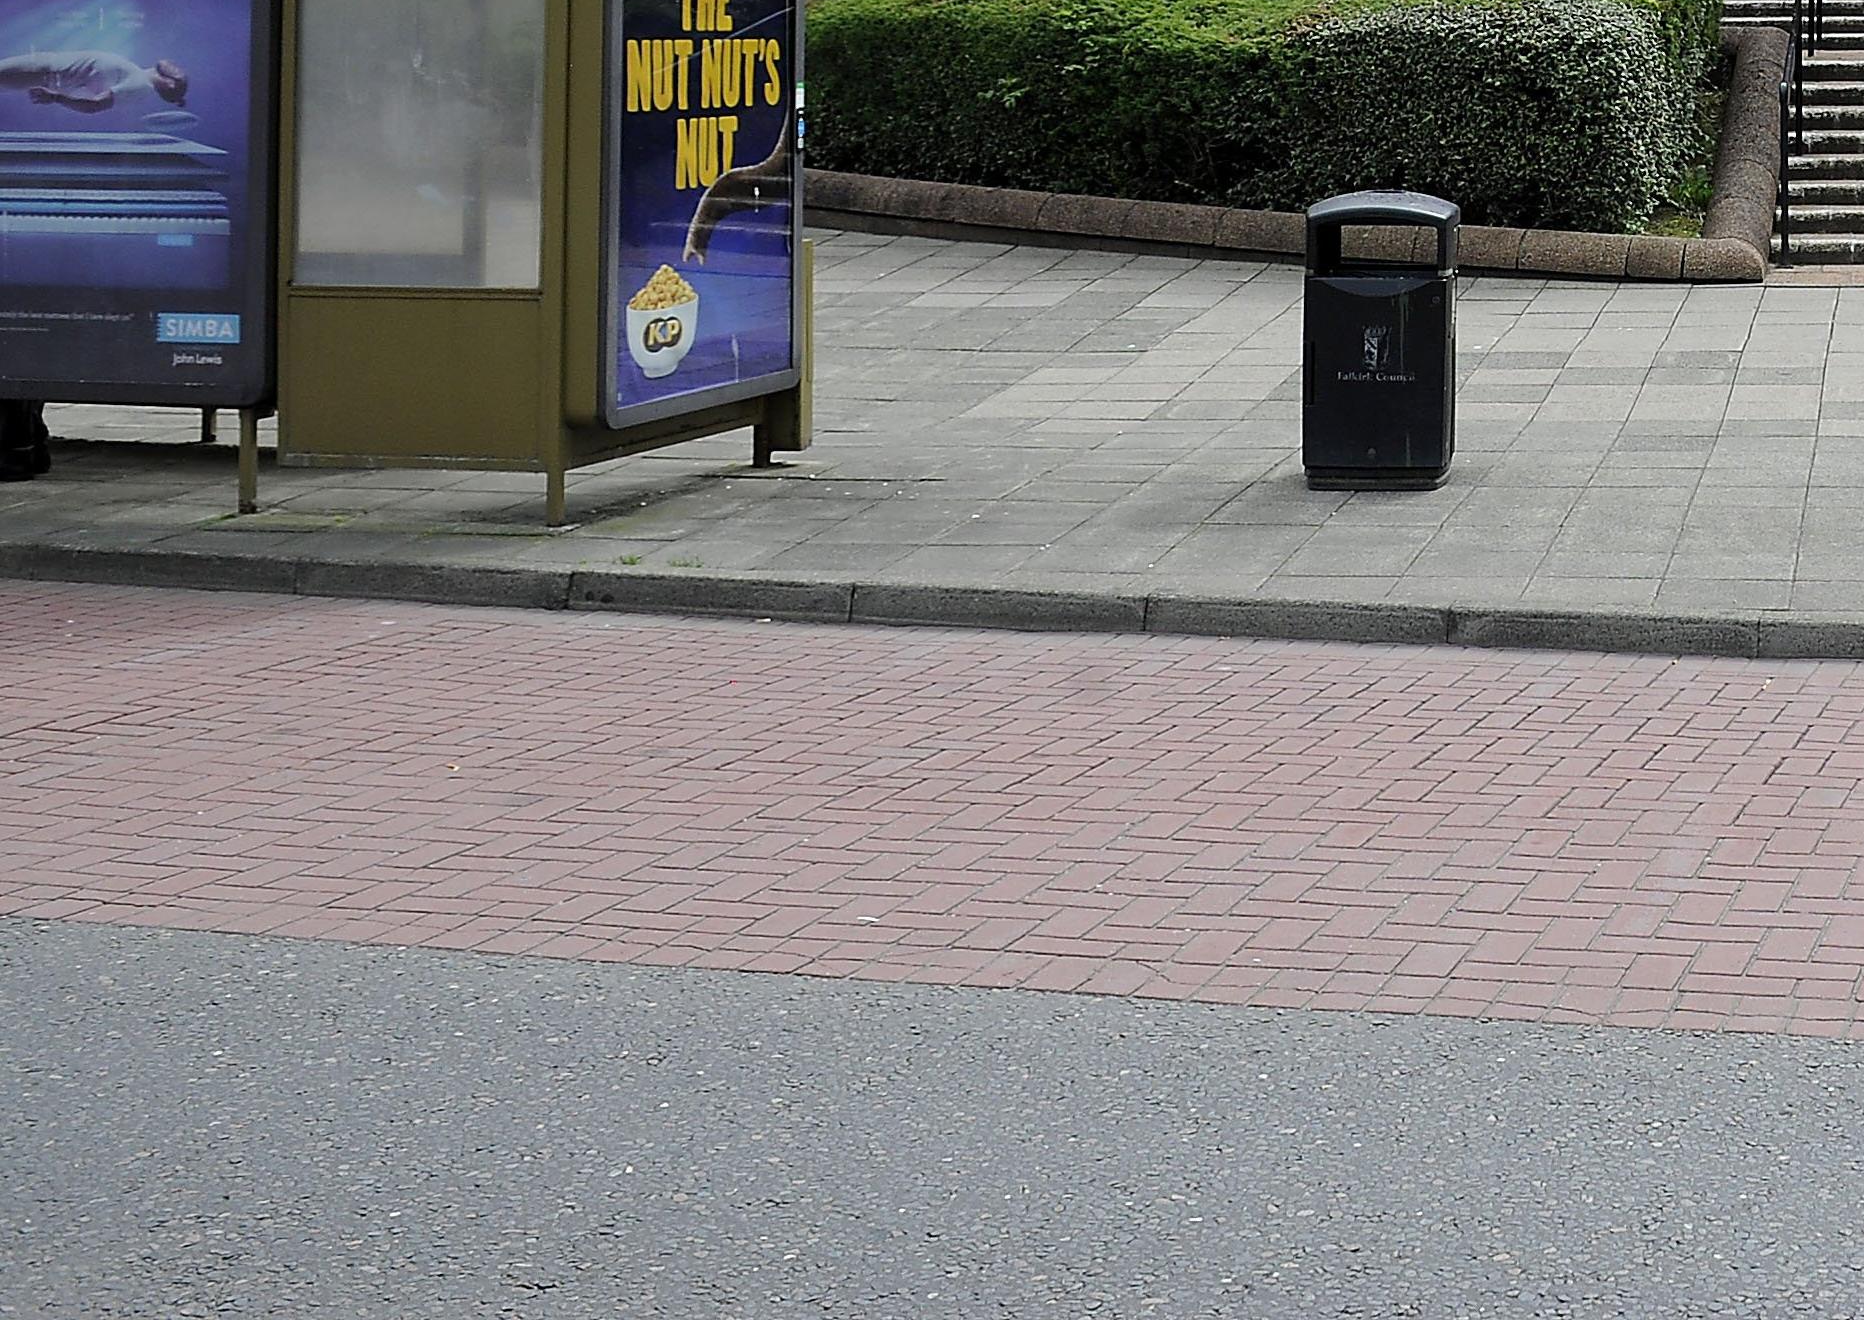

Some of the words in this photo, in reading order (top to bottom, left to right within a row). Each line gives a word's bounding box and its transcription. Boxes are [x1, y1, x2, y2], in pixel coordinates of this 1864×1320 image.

[627, 39, 693, 112] NUT
[701, 38, 781, 109] NUT'S
[675, 115, 738, 190] NUT
[166, 319, 234, 338] SIMBA
[648, 320, 680, 346] KP
[172, 353, 195, 366] John
[196, 354, 223, 365] Lewis
